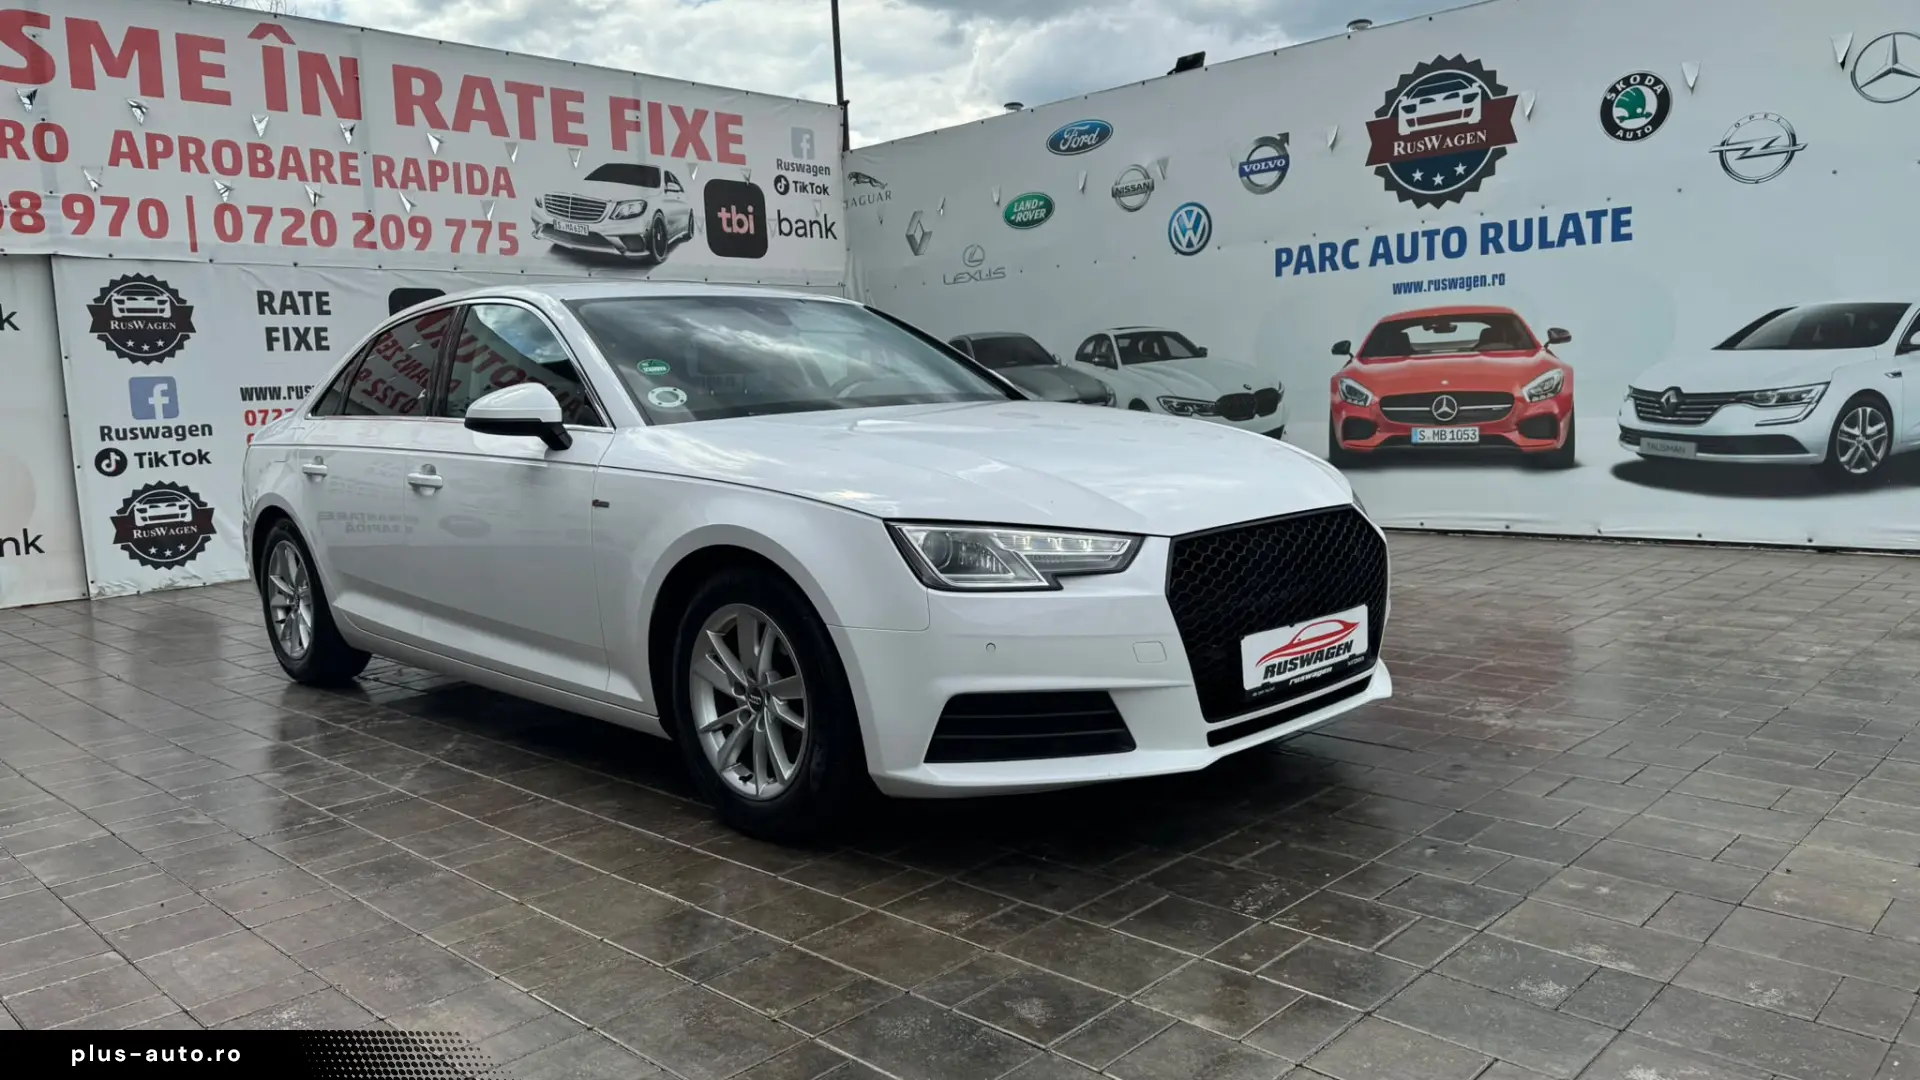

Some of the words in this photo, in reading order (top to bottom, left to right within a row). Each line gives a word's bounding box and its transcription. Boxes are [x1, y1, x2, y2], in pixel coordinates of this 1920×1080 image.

[0, 9, 231, 106] SME
[247, 22, 363, 120] ÎN
[391, 63, 588, 147] RATE
[609, 96, 747, 165] FIXE
[1734, 113, 1781, 128] OPEL
[1060, 125, 1100, 150] Ford
[1615, 125, 1653, 139] AUTO
[0, 118, 69, 163] RO
[108, 130, 360, 187] APROBARE
[373, 155, 516, 199] RAPIDA
[776, 158, 831, 177] Ruswagen
[1242, 158, 1286, 173] VOLVO
[792, 180, 830, 196] TikTok
[1115, 182, 1150, 195] NISSAN
[843, 190, 892, 210] JAGUAR
[1013, 199, 1039, 213] LAND
[61, 193, 169, 239] 970
[213, 203, 337, 248] 0720
[352, 212, 432, 251] 209
[445, 219, 518, 256] 775
[717, 205, 754, 235] tbi
[776, 209, 838, 240] bank
[1015, 208, 1047, 223] ROVER
[1275, 239, 1359, 278] PARC
[1370, 226, 1468, 267] AUTO
[1480, 206, 1633, 256] RULATE
[943, 266, 1007, 286] LEXUS
[1393, 273, 1506, 295] www.ruswagen.ro
[256, 290, 332, 316] RATE
[265, 326, 330, 352] FIXE
[99, 423, 213, 442] Ruswagen
[133, 448, 212, 469] TikTok
[1263, 639, 1353, 680] RUSWAGEN
